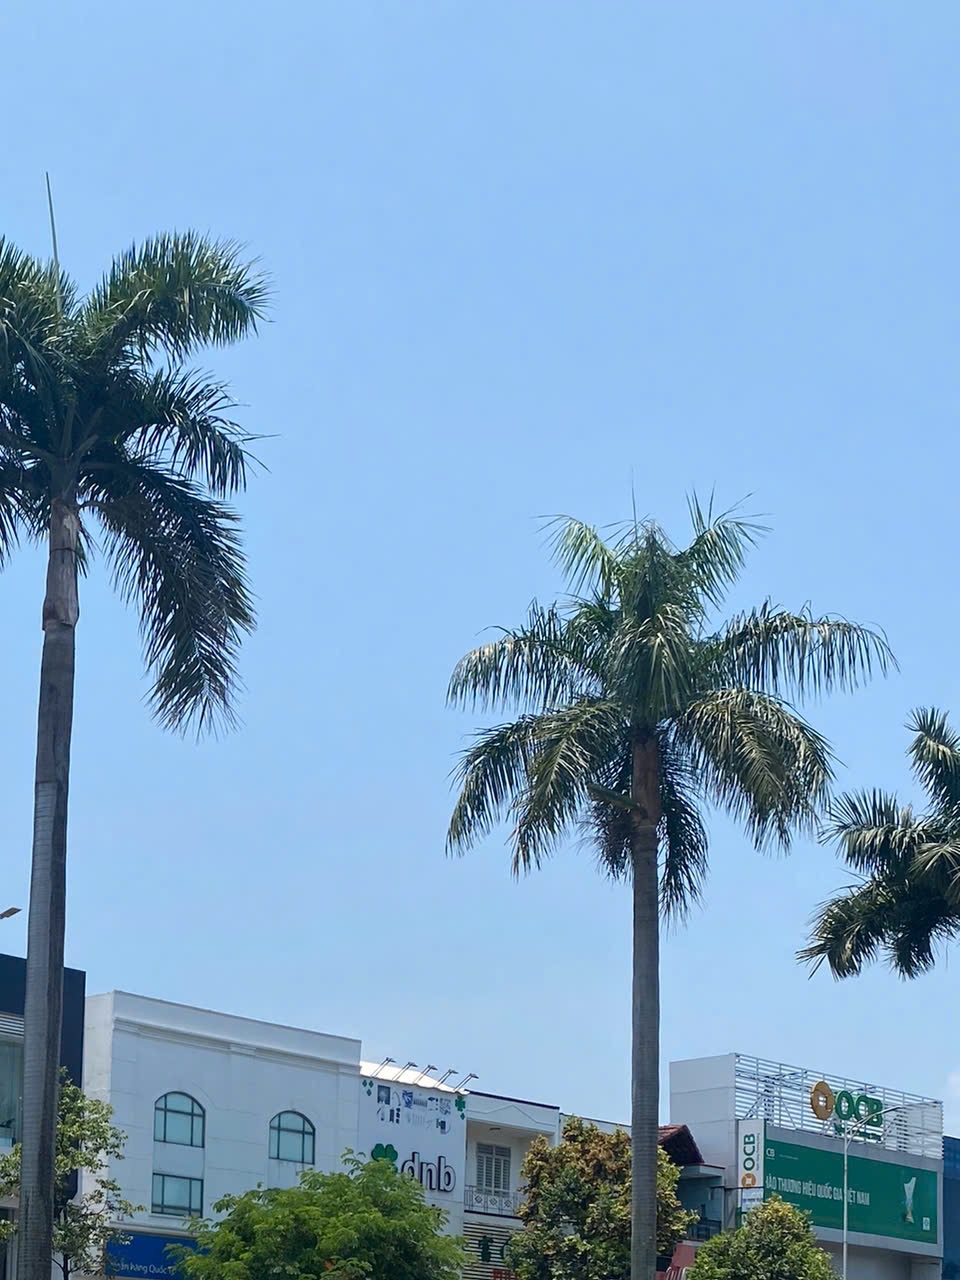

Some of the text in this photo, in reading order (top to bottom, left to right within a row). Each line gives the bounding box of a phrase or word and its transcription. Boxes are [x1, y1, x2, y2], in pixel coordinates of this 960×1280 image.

[835, 1090, 883, 1127] OCB
[743, 1133, 755, 1171] OCB
[401, 1151, 456, 1193] dnb
